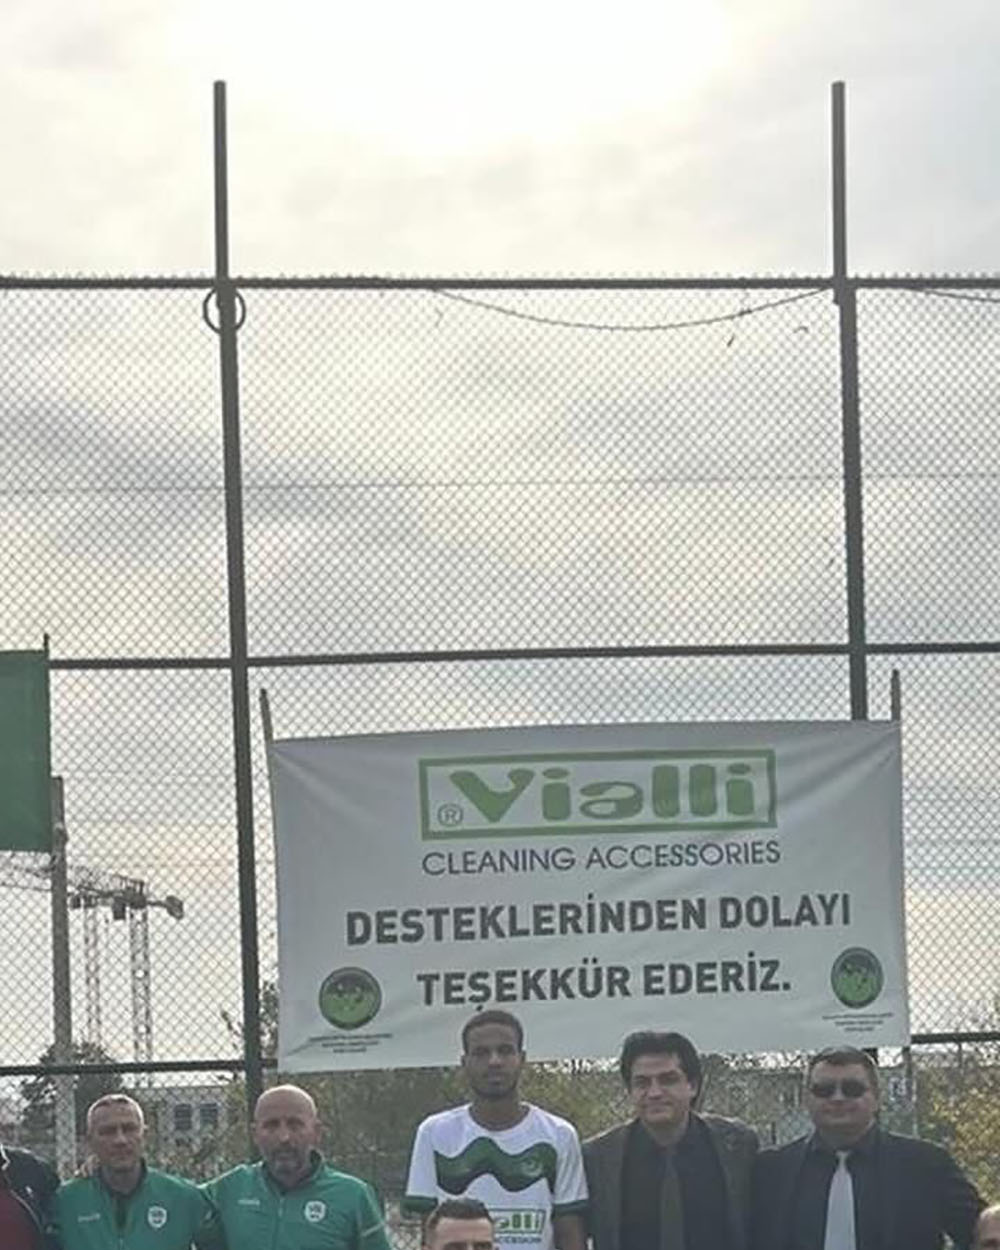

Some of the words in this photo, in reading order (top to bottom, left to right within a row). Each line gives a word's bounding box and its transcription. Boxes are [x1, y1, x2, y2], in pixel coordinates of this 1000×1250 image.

[450, 763, 757, 824] Vialli
[422, 845, 576, 878] CLEANING
[585, 839, 782, 871] ACCESSORIES
[346, 893, 707, 946] DESTEKLERİNDEN
[720, 893, 852, 929] DOLAYI
[417, 956, 631, 1012] TEŞEKKÜR
[643, 950, 792, 994] EDERİZ.
